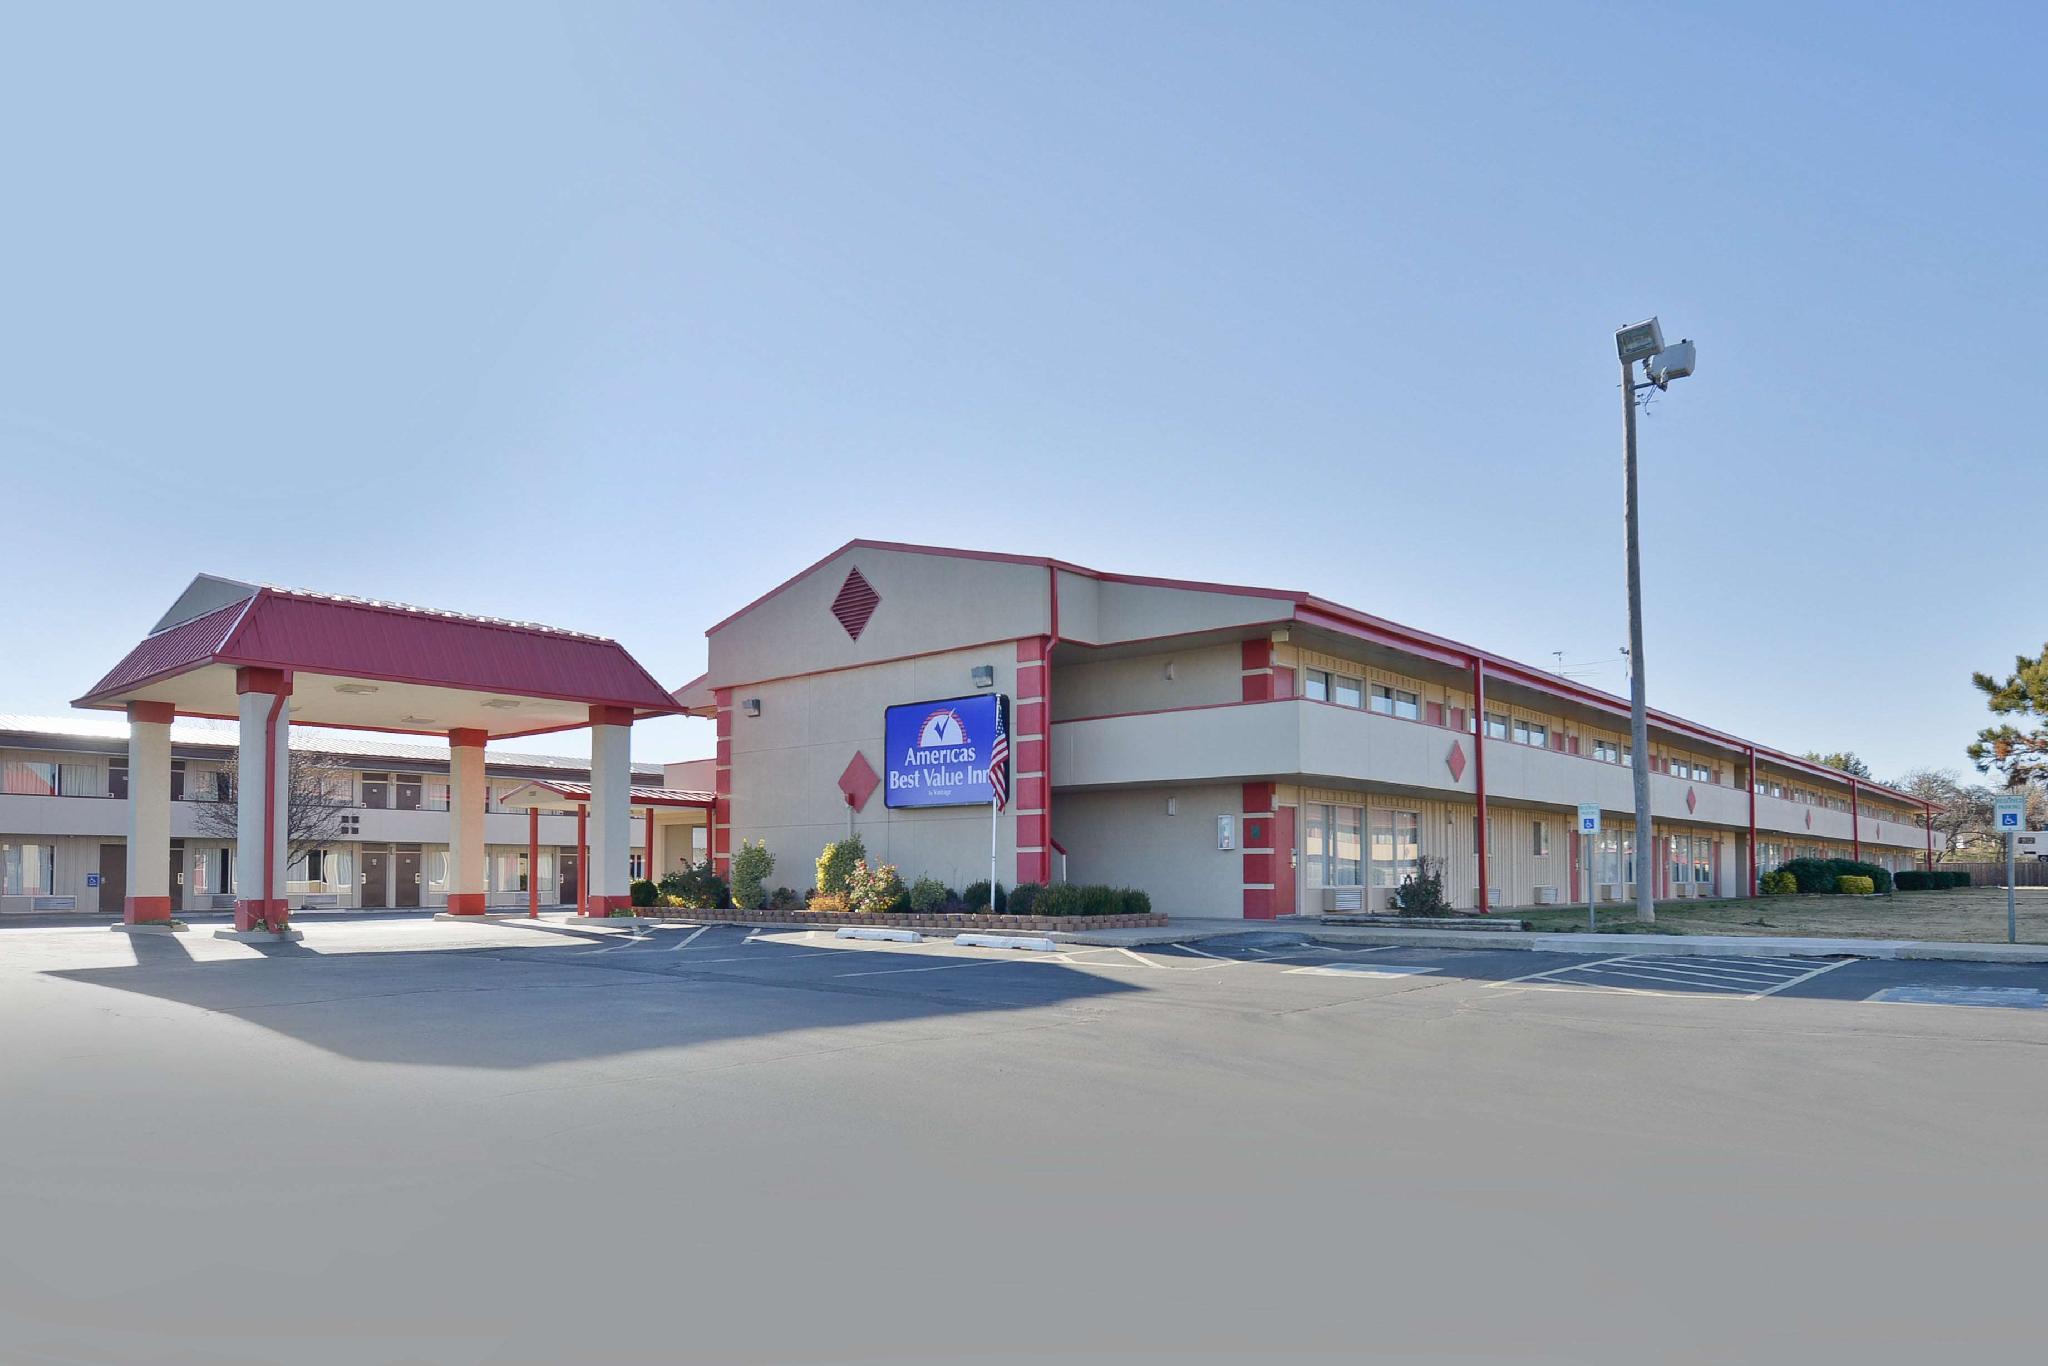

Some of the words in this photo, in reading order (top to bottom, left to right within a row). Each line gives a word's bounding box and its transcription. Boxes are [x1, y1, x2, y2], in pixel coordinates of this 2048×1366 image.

[904, 747, 976, 766] Americas
[889, 770, 920, 789] Best
[923, 765, 963, 787] Value
